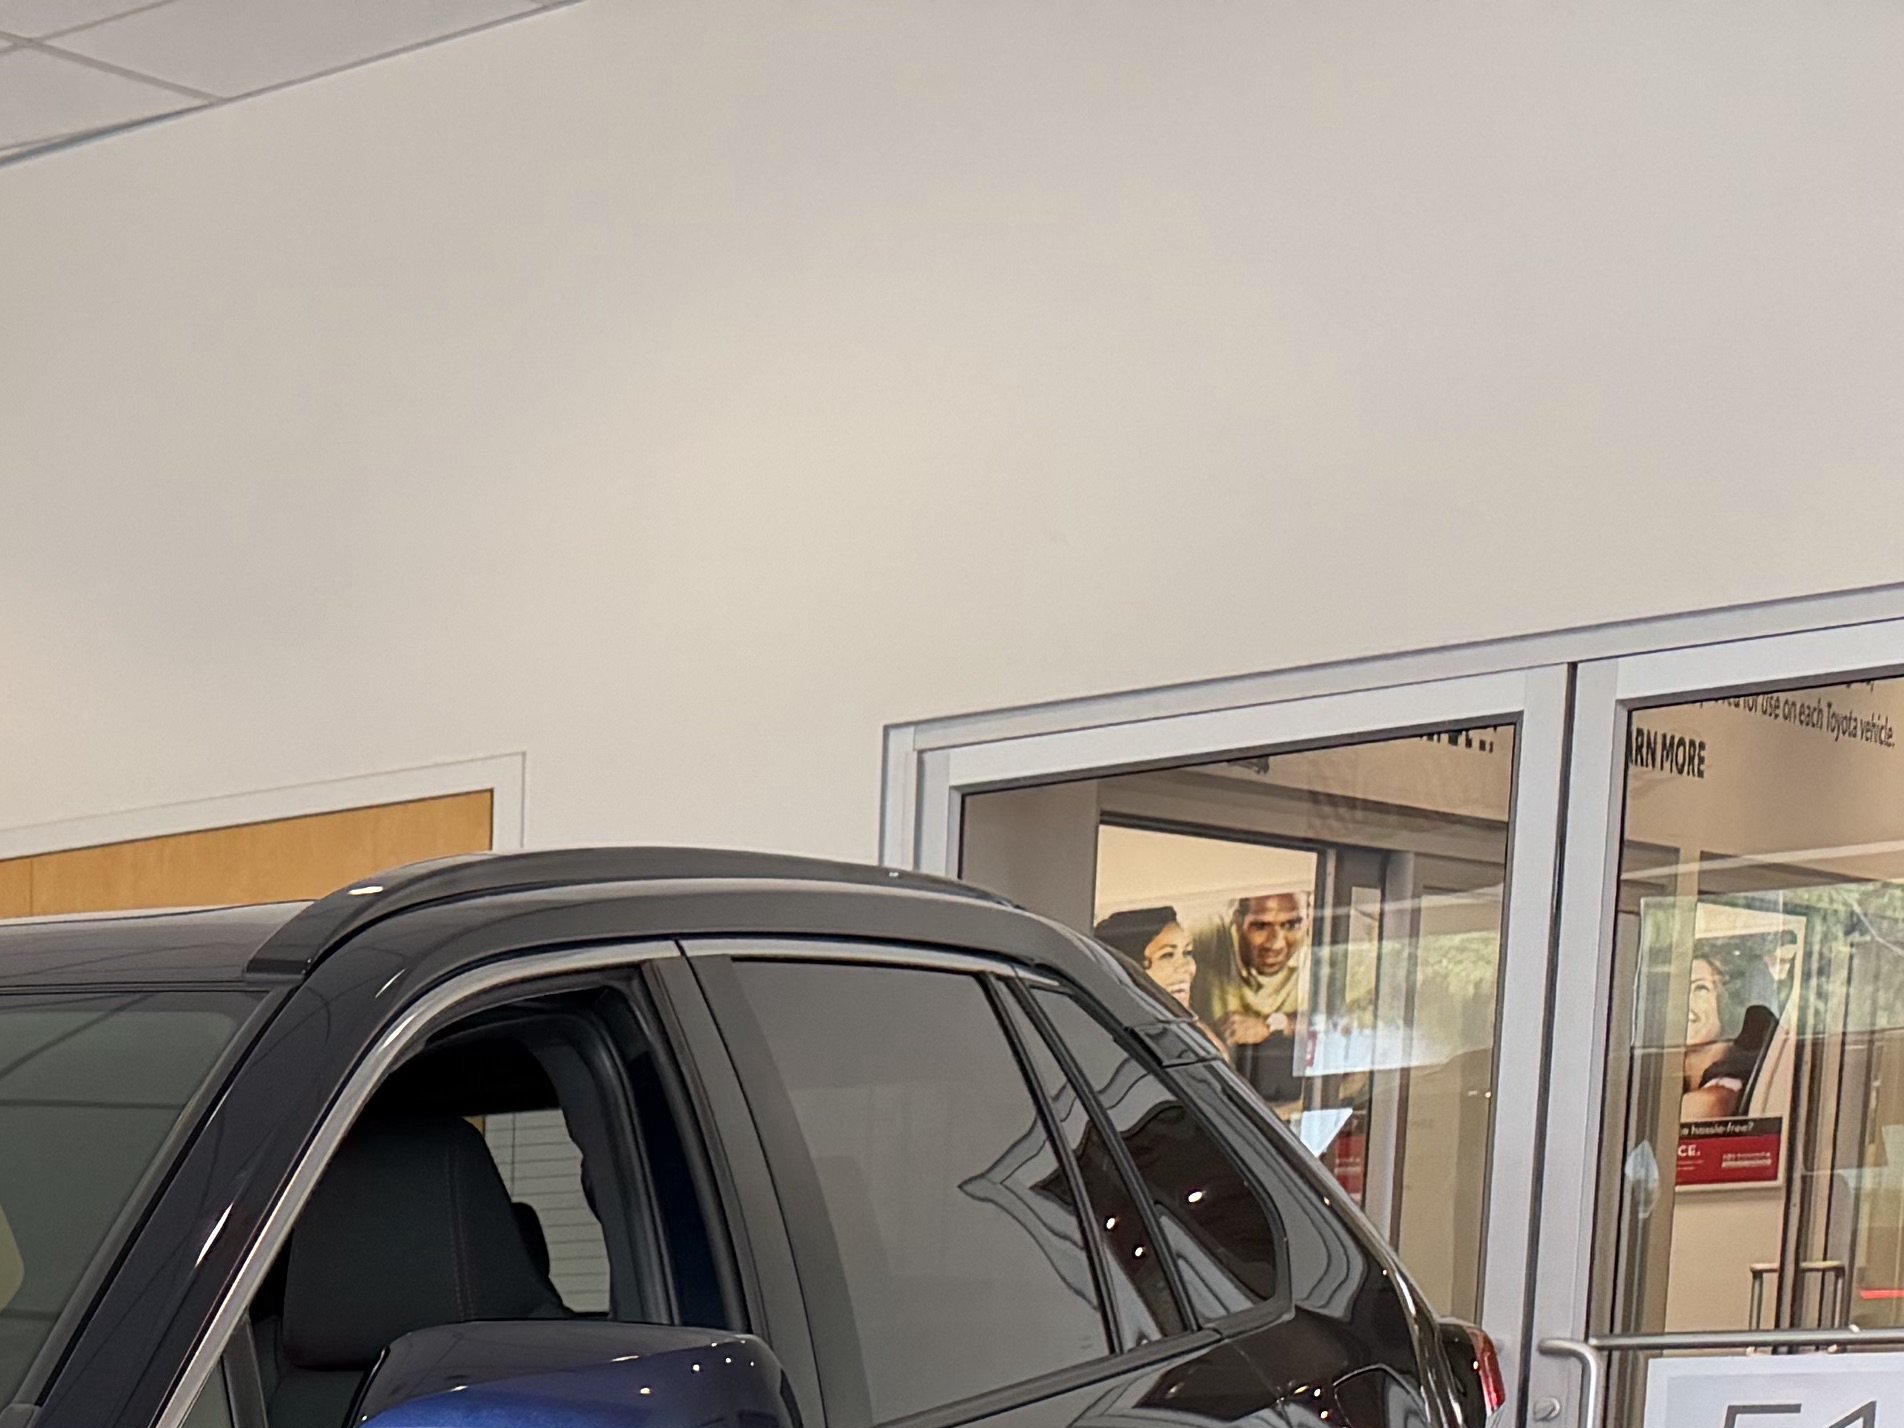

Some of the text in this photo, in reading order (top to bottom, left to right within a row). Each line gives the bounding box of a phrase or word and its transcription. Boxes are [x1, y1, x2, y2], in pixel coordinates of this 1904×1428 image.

[1761, 695, 1780, 720] use
[1783, 698, 1797, 725] on
[1798, 697, 1823, 731] each
[1827, 702, 1858, 742] Toyota
[1660, 732, 1706, 779] MORE
